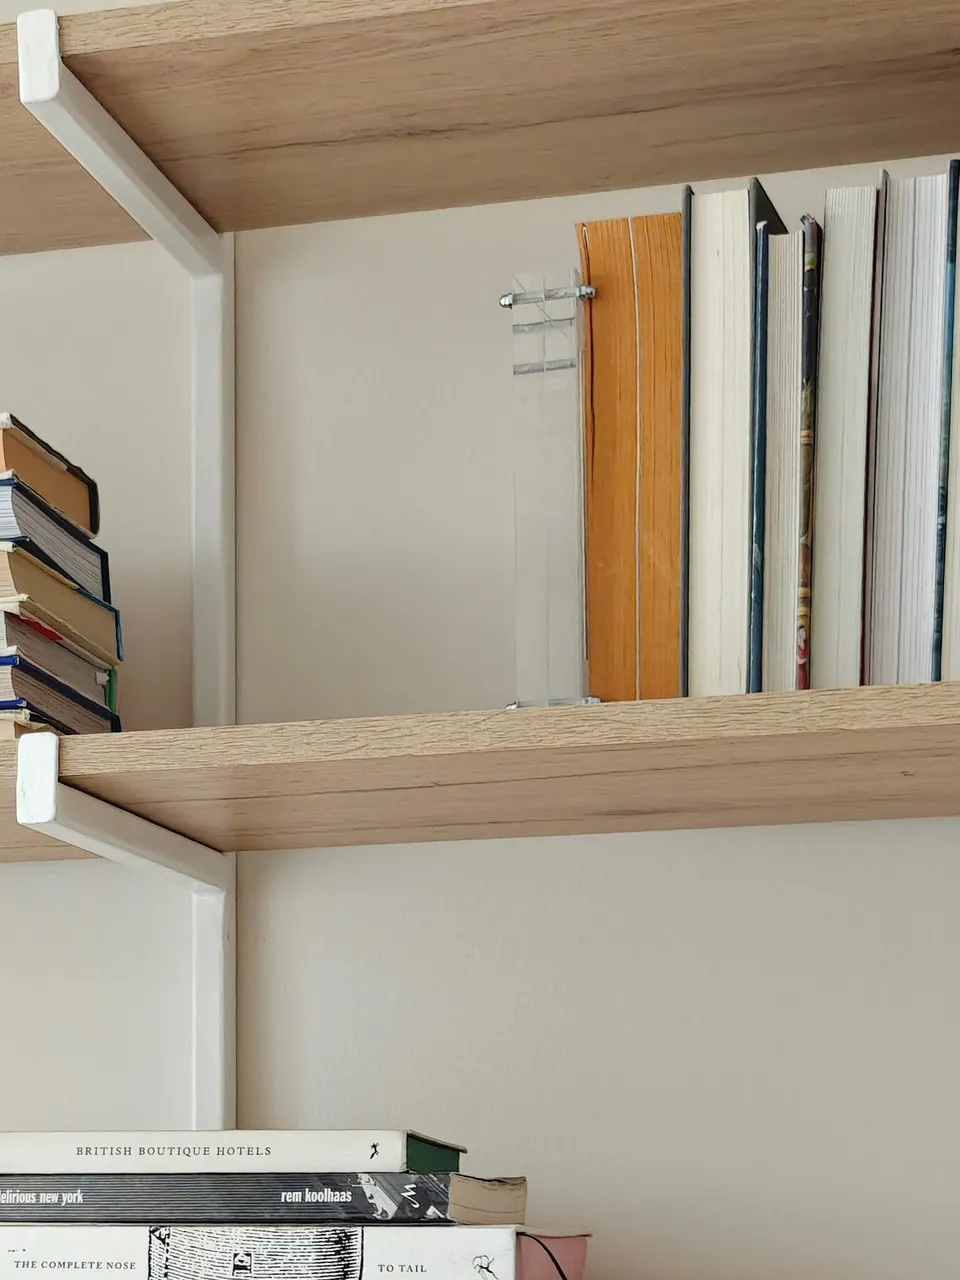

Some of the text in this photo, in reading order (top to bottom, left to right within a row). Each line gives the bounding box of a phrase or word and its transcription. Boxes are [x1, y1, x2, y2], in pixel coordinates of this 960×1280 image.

[76, 1146, 272, 1158] BRITISH BOUTIQUE HOTELS
[40, 1193, 59, 1204] new
[61, 1190, 84, 1206] york
[281, 1188, 352, 1203] rem koolhaas
[14, 1260, 137, 1270] THE COMPLETE NOSE
[377, 1264, 427, 1273] TO TAIL
